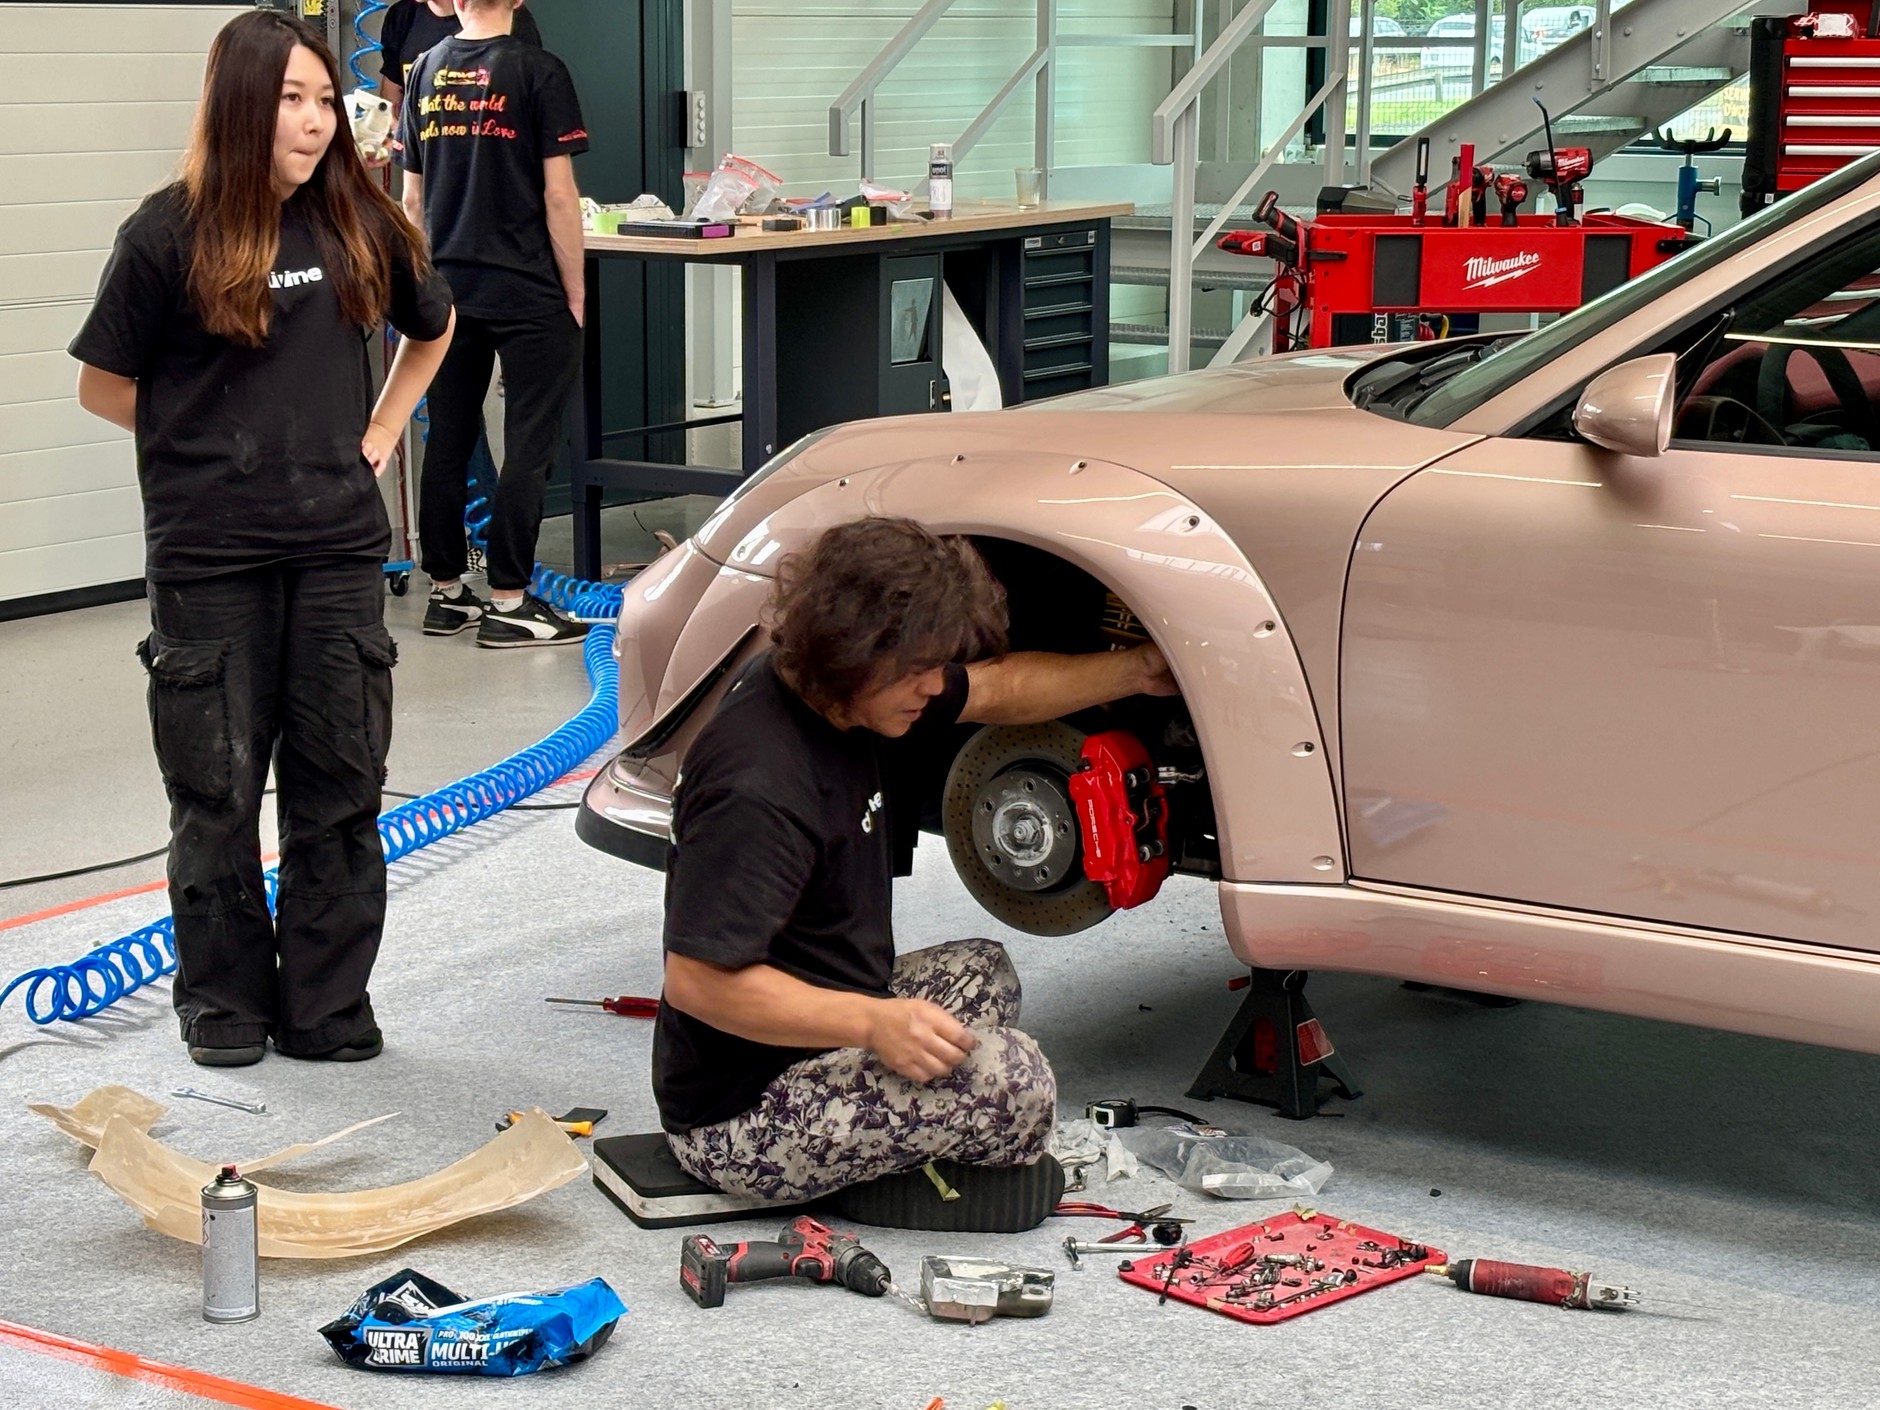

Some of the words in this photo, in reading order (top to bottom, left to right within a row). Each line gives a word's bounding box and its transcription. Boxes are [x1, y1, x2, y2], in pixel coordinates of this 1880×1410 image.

[442, 94, 466, 111] the
[441, 125, 467, 137] now
[481, 119, 517, 139] Love
[1462, 251, 1540, 282] Milwaukee
[368, 1331, 419, 1350] ULTRA
[437, 1330, 455, 1339] PRO
[432, 1360, 488, 1368] ORIGINAL
